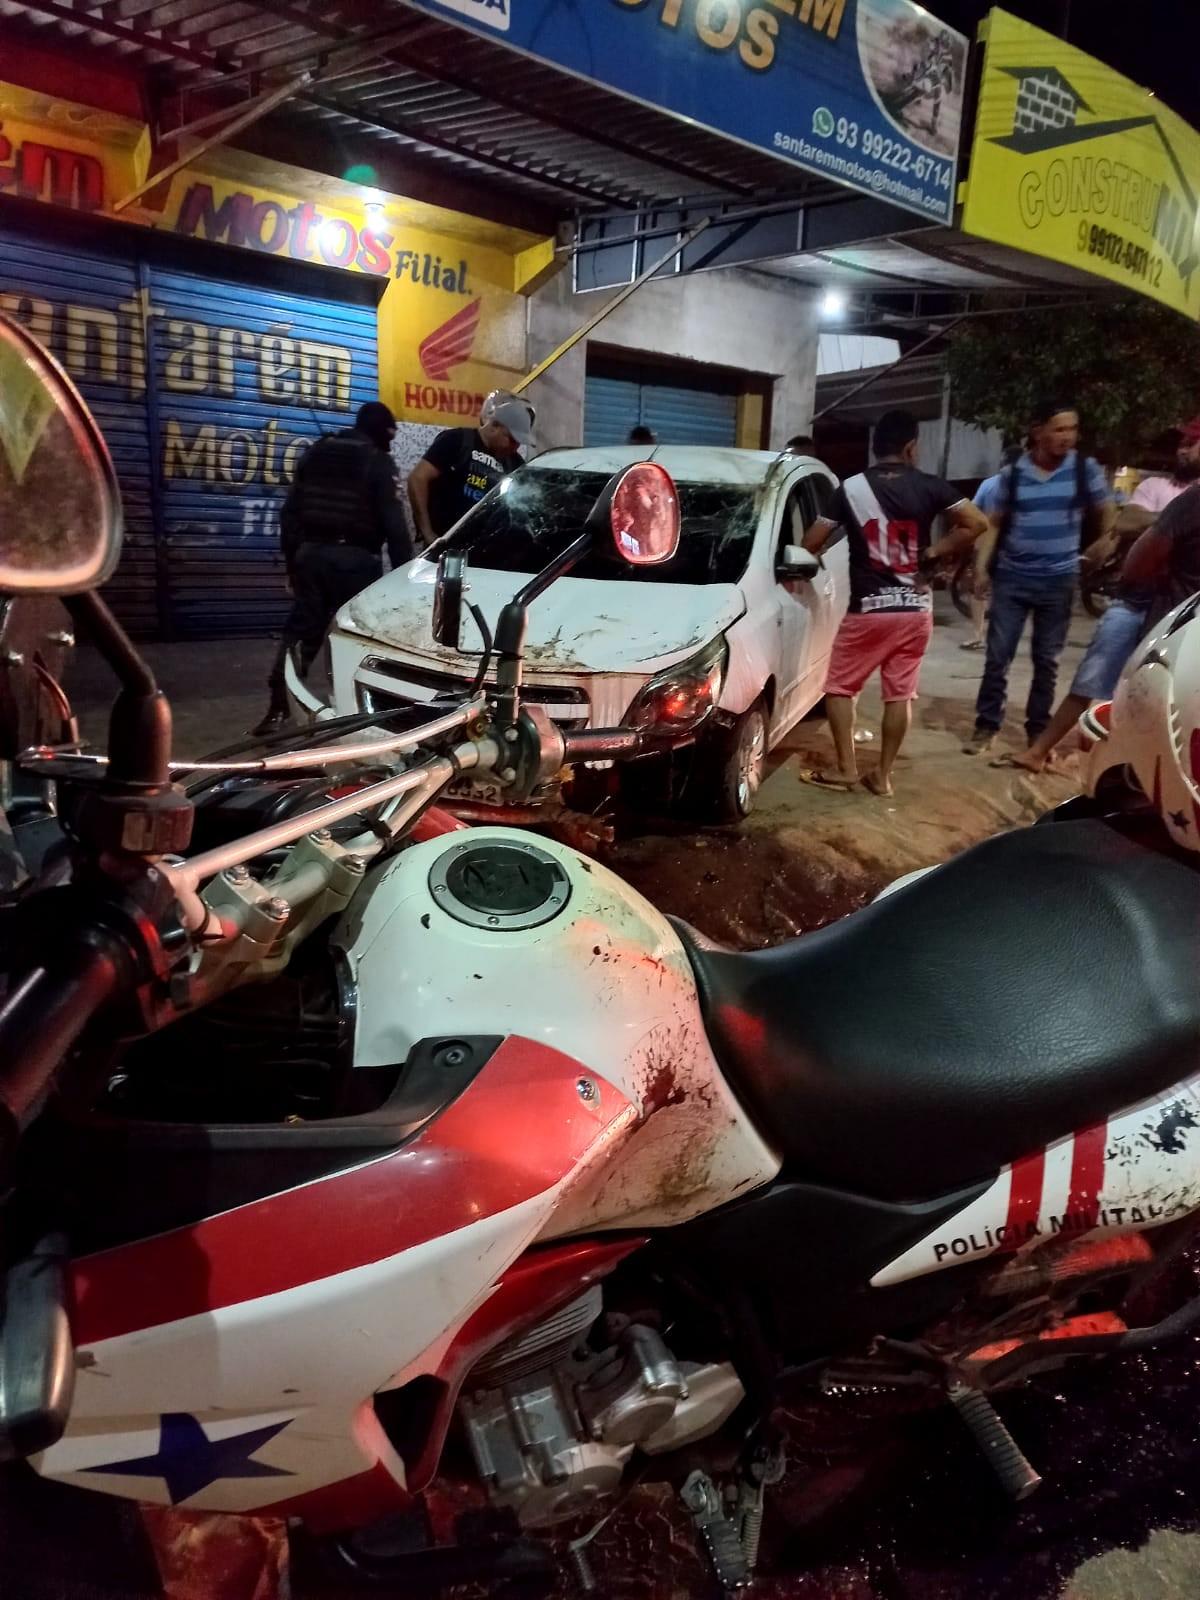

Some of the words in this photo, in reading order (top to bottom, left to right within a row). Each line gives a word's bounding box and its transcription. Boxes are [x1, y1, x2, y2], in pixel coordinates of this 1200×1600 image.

[773, 131, 948, 214] santaremmotos@hotmail.com
[836, 117, 859, 148] 93
[862, 129, 950, 190] 99222-6714
[396, 250, 473, 295] Filial.
[163, 412, 316, 485] Moto
[933, 1219, 1042, 1262] POLÍCIA
